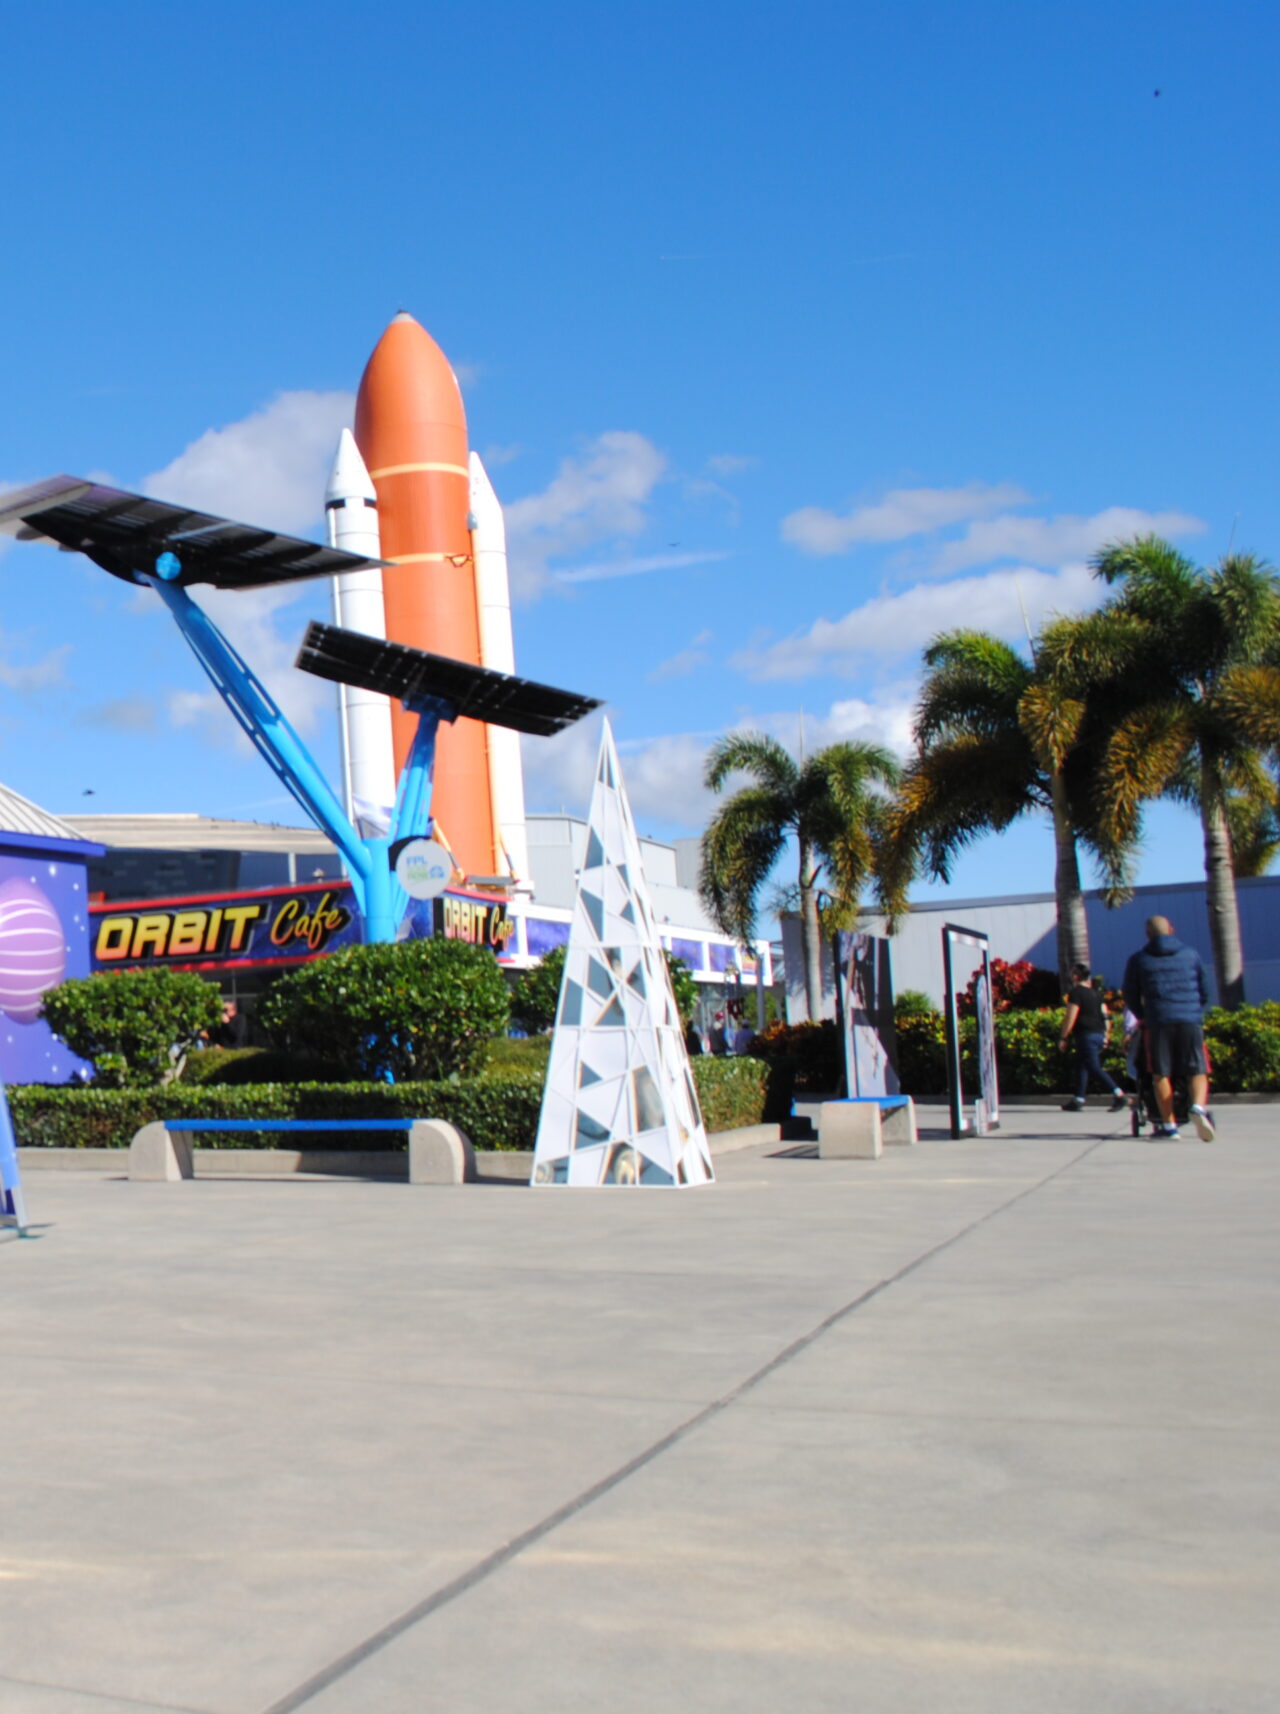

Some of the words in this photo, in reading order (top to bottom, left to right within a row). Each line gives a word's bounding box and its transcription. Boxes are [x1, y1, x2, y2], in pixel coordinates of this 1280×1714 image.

[95, 905, 260, 960] ORBIT
[271, 892, 342, 949] Cafe
[443, 896, 487, 944] ORBIT
